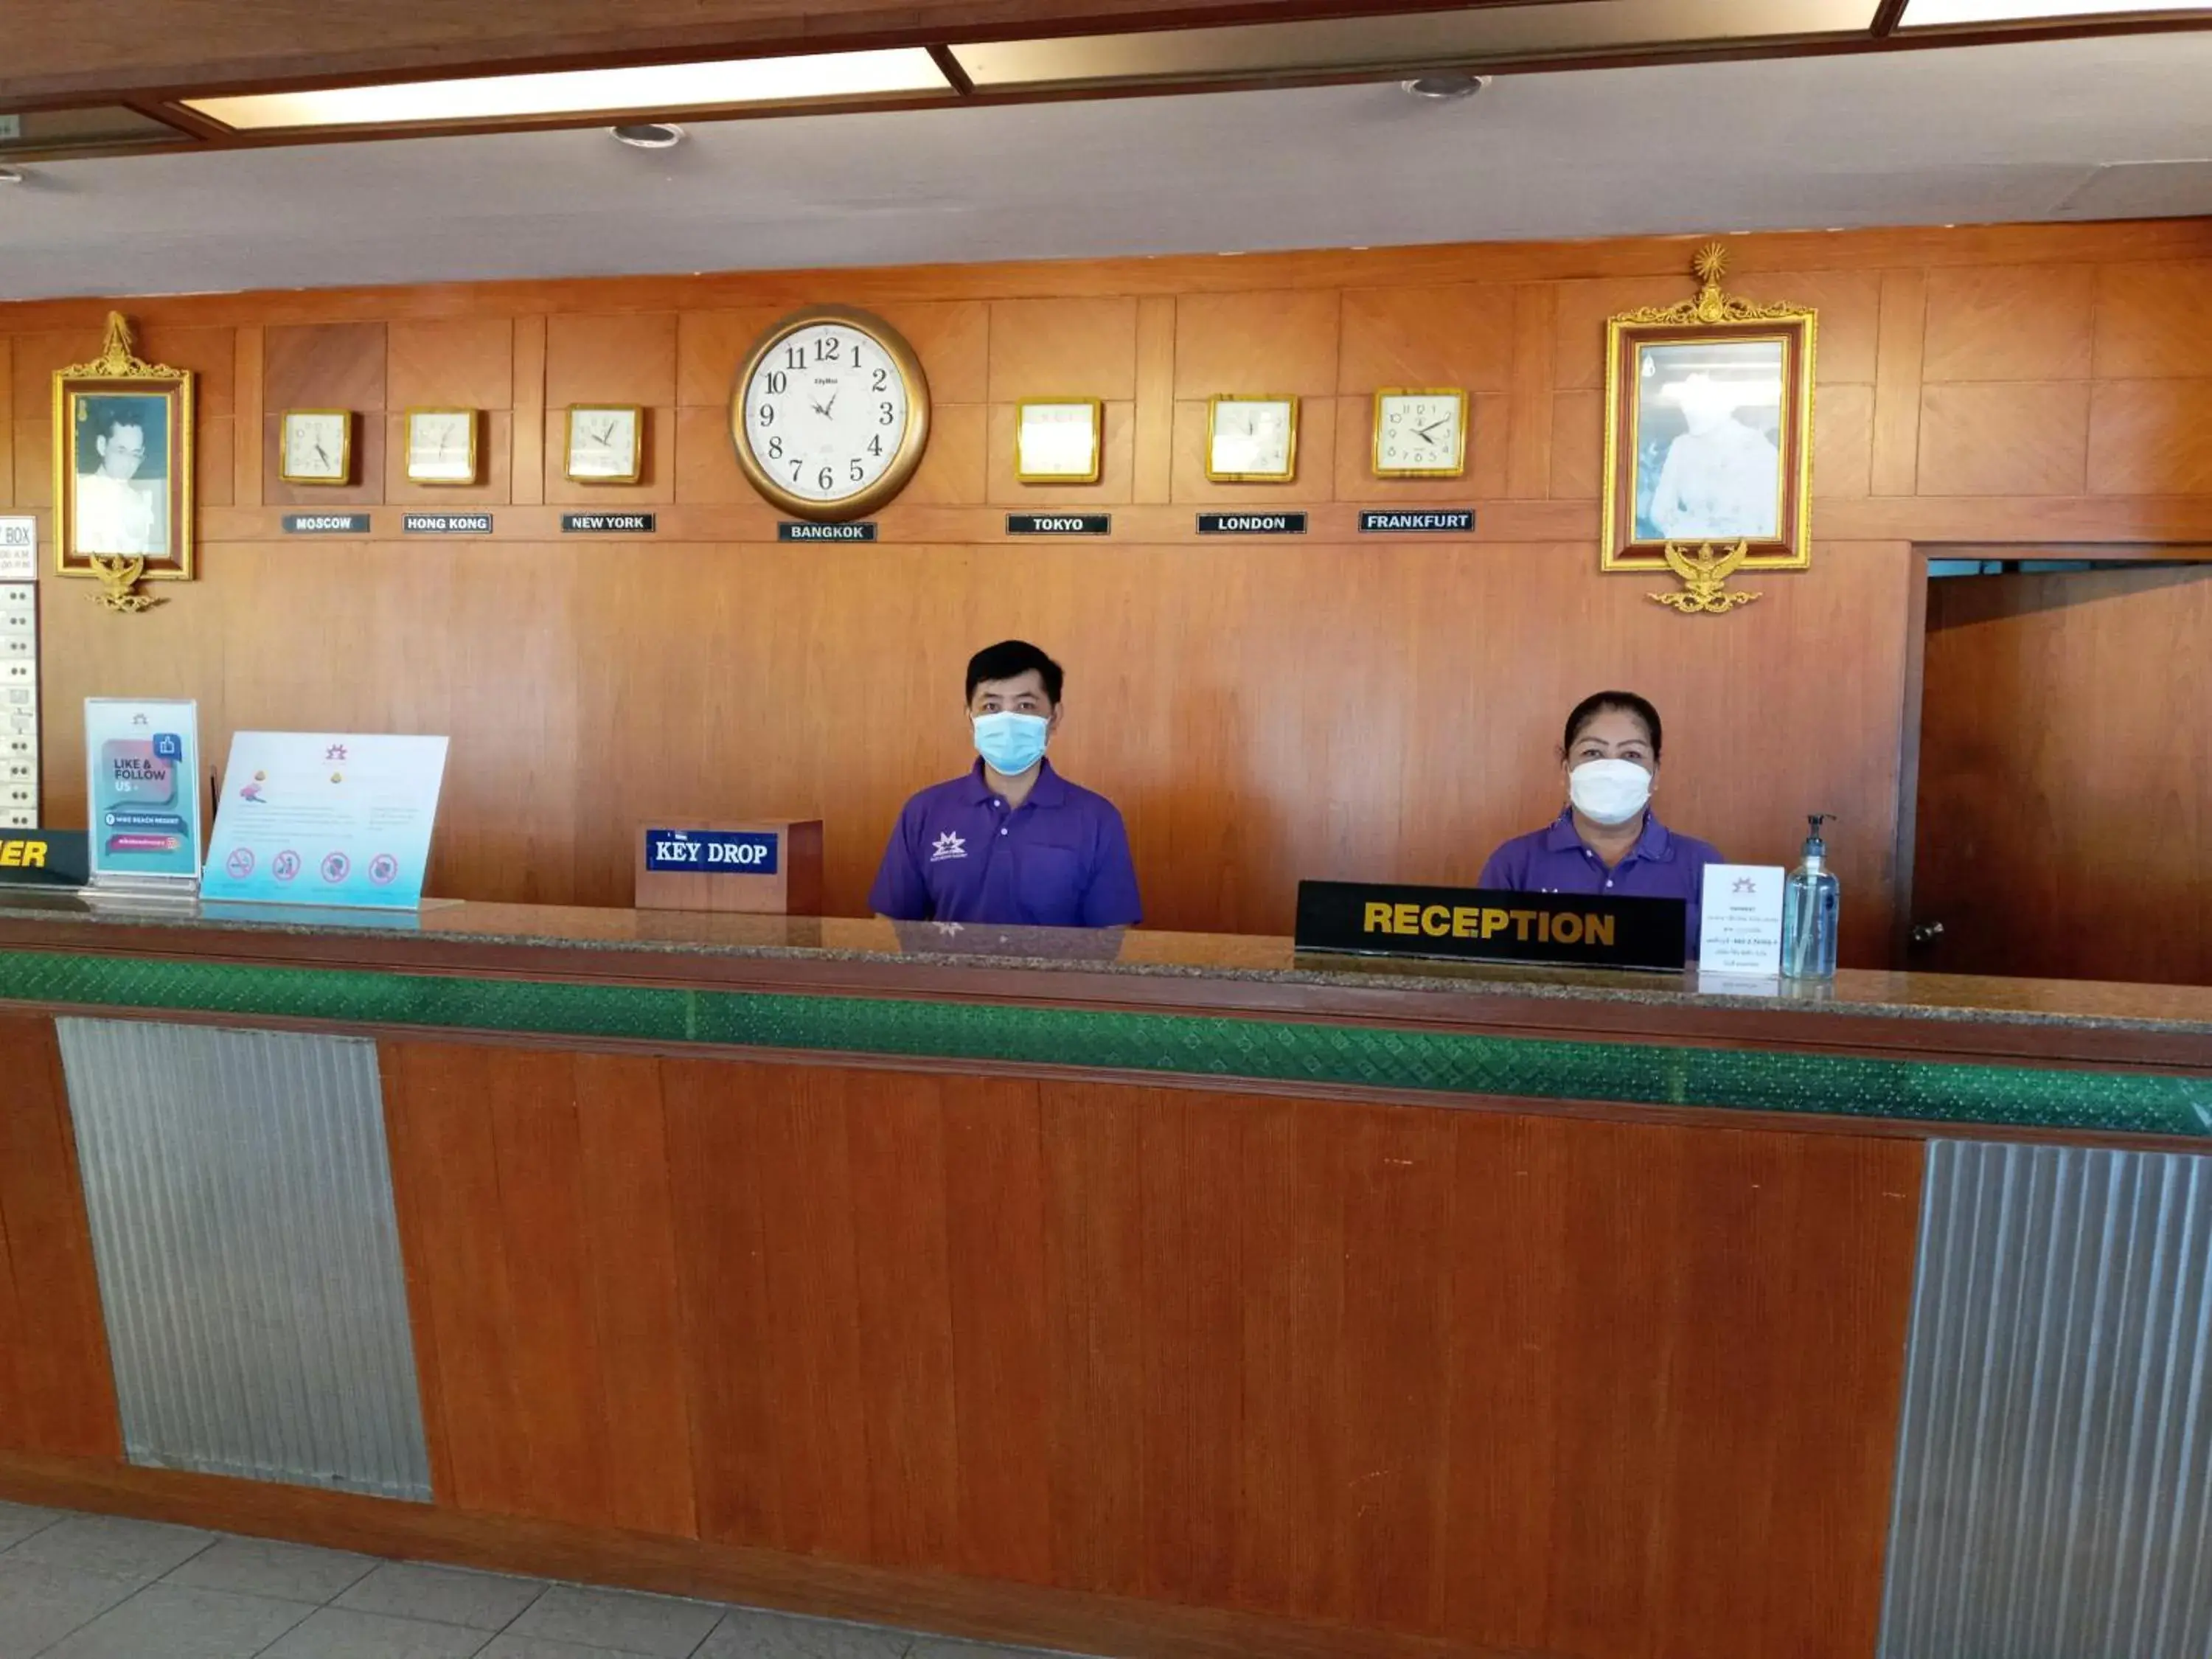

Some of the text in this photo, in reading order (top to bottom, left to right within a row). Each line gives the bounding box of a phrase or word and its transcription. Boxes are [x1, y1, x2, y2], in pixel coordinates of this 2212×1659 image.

[785, 347, 807, 369] 11
[814, 337, 840, 361] 12
[850, 346, 862, 368] 1
[765, 371, 787, 394] 10
[872, 369, 887, 392] 2
[760, 403, 774, 426] 9
[880, 402, 894, 425] 3
[768, 437, 783, 459] 8
[867, 434, 883, 456] 4
[790, 459, 803, 481] 7
[818, 467, 833, 490] 6
[849, 459, 863, 481] 5
[296, 518, 352, 529] MOSCOW
[408, 518, 487, 529] HONG KONG
[572, 517, 644, 529] NEW YORK
[791, 526, 863, 538] BANGKOK
[1033, 518, 1083, 530] TOKYO
[1218, 518, 1285, 530] LONDON
[1368, 514, 1469, 529] FRANKFURT
[6, 526, 30, 543] BOX
[114, 759, 151, 769] LIKE &
[114, 769, 166, 780] FOLLOW
[115, 781, 131, 792] US
[0, 840, 48, 867] ER
[655, 841, 768, 863] KEY DROP
[1363, 902, 1615, 946] RECEPTION
